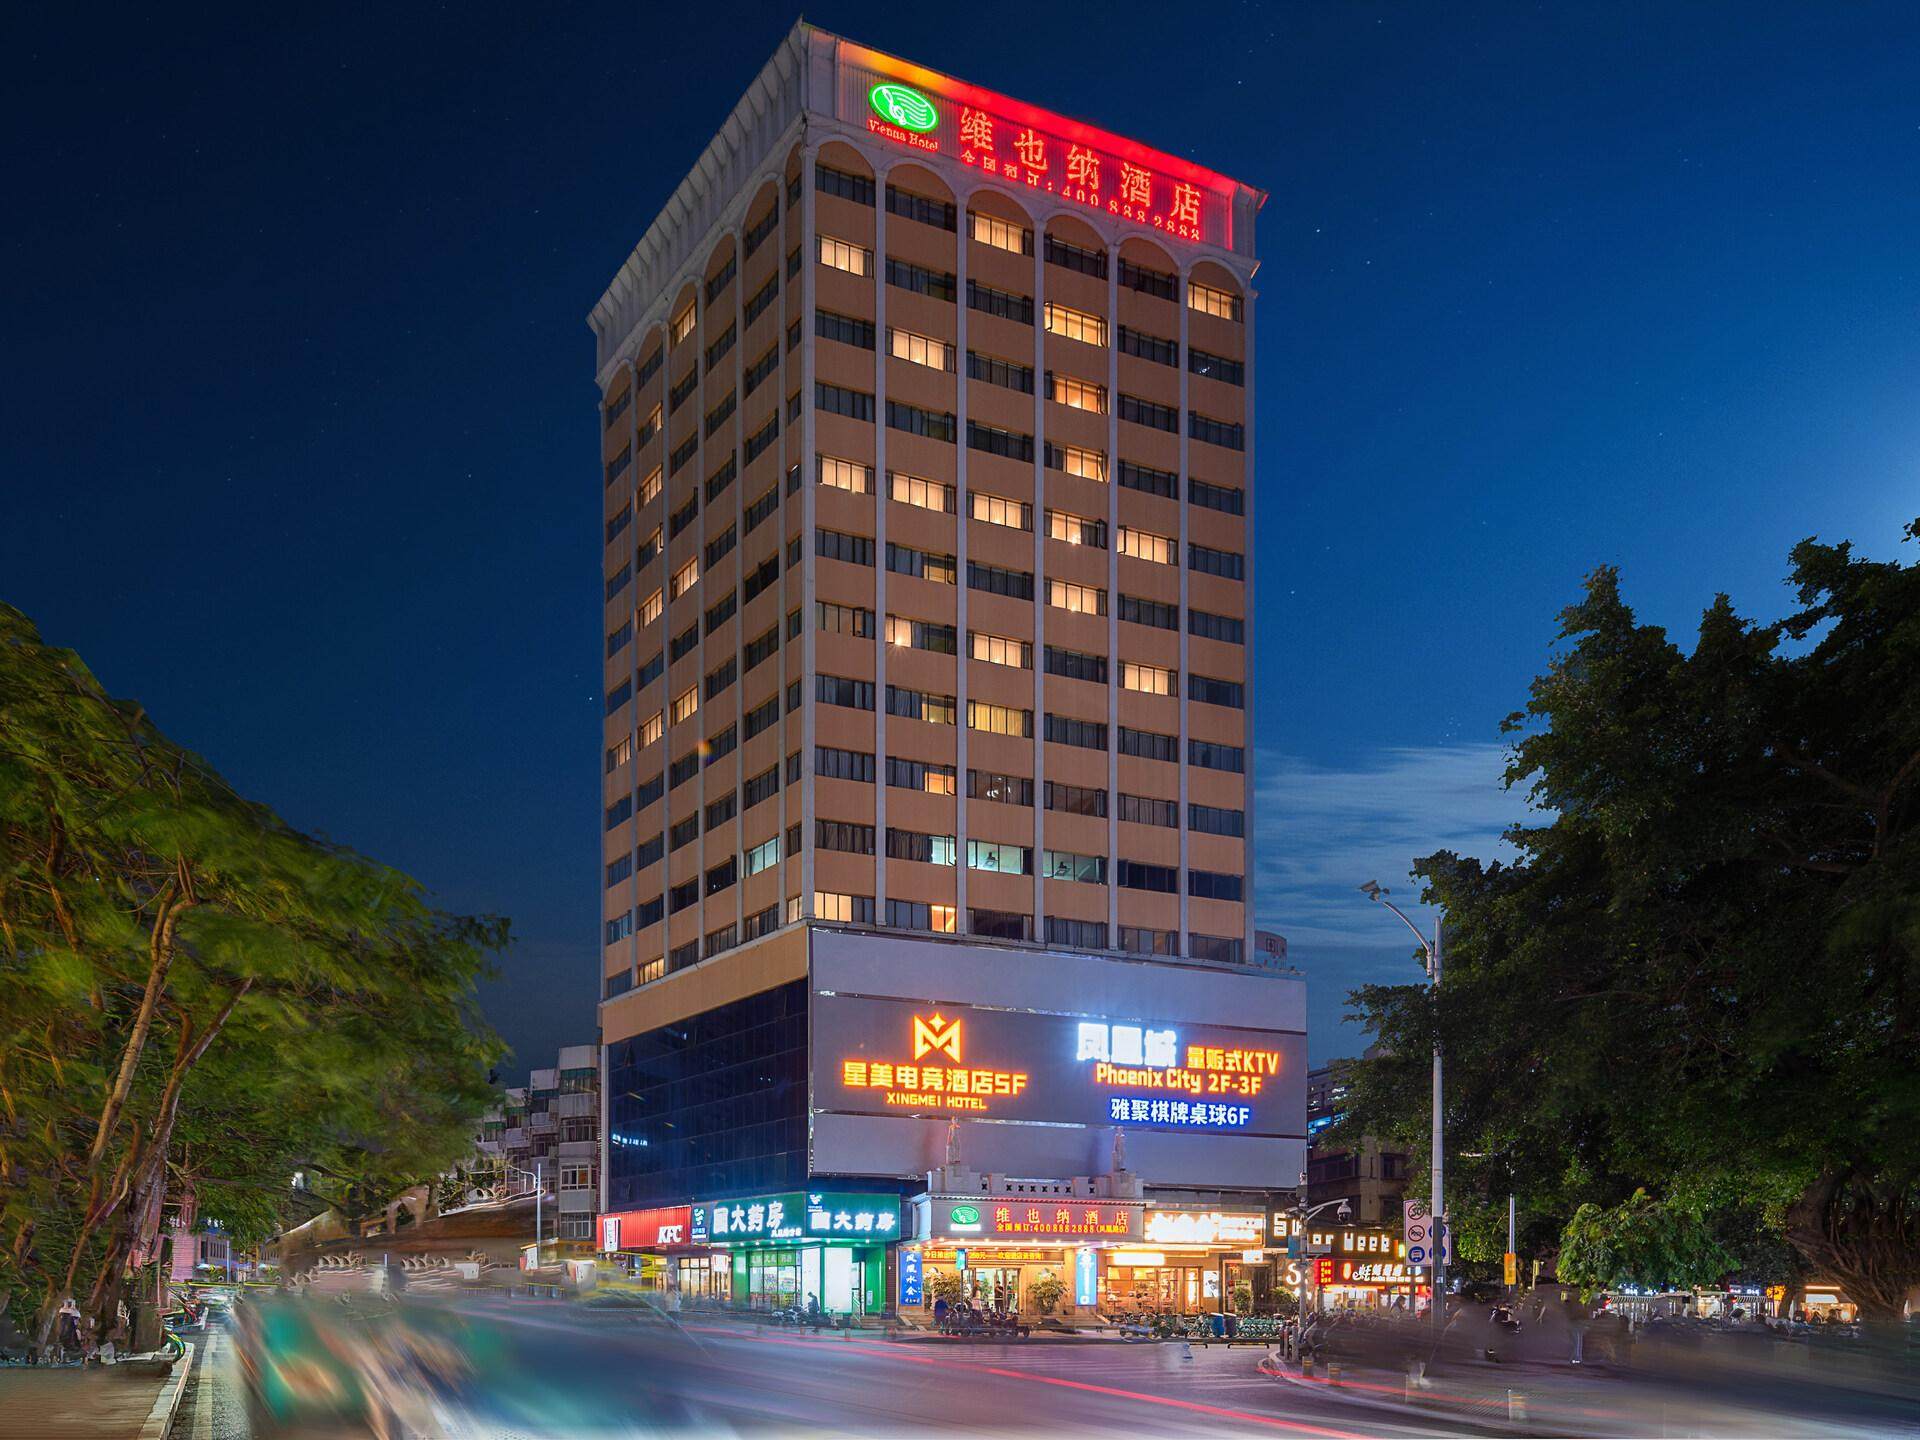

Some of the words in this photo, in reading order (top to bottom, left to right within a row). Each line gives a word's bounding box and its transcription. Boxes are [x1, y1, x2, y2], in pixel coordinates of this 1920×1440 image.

[868, 119, 906, 142] Vienna
[909, 132, 938, 150] Hotel
[960, 107, 1201, 225] 维也纳酒店
[1187, 1046, 1279, 1074] 量贩式KTV
[1096, 1062, 1162, 1088] Phoenix
[1166, 1068, 1202, 1094] City
[1207, 1073, 1262, 1095] 2F-3F
[886, 1093, 941, 1107] XINGMEI
[946, 1096, 987, 1110] HOTEL
[1111, 1098, 1250, 1125] 雅聚棋牌桌球6F
[996, 1207, 1129, 1226] 维也纳酒店
[657, 1225, 684, 1244] KFC
